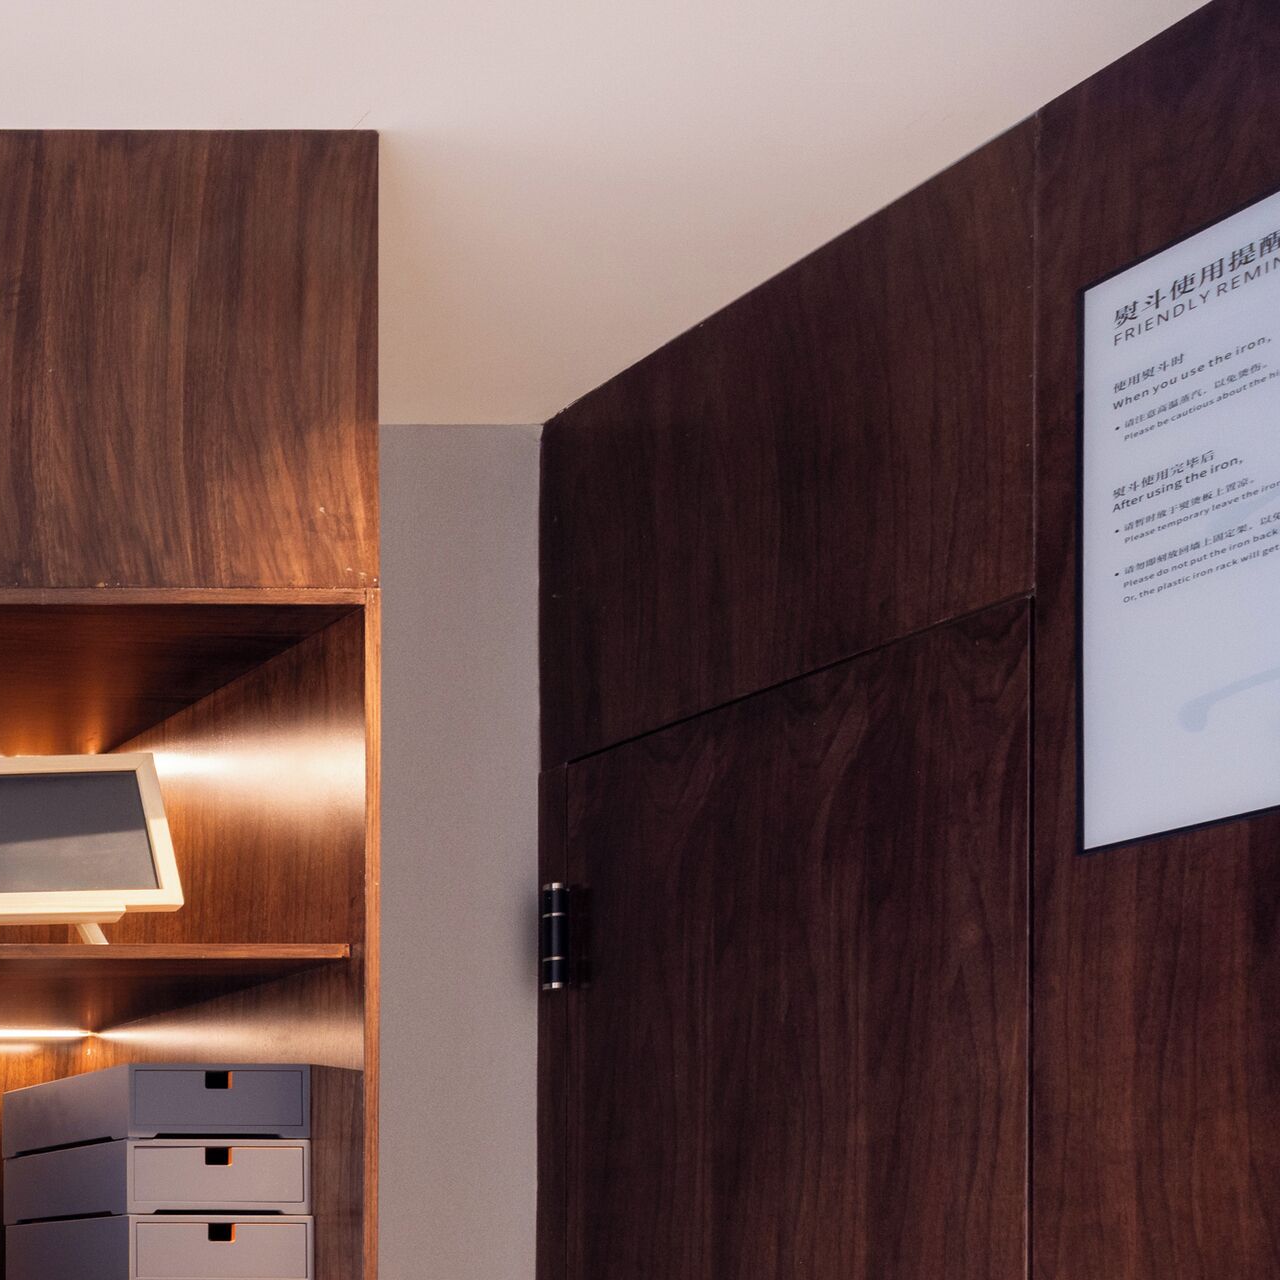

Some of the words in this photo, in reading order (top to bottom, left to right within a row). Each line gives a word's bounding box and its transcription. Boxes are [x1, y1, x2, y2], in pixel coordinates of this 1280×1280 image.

[1114, 290, 1210, 346] FRIENDLY
[1113, 353, 1184, 393] 使用熨斗时
[1113, 390, 1149, 410] When
[1153, 376, 1178, 395] you
[1181, 365, 1205, 380] use
[1208, 352, 1232, 368] the
[1236, 336, 1271, 356] iron,
[1124, 425, 1155, 440] Please
[1157, 418, 1169, 428] be
[1170, 399, 1214, 421] cautious
[1216, 384, 1247, 402] about
[1249, 376, 1266, 388] the
[1112, 494, 1144, 513] After
[1146, 480, 1182, 499] using
[1185, 470, 1207, 483] the
[1210, 456, 1243, 474] iron,
[1113, 450, 1215, 499] 熨斗使用完毕后
[1124, 528, 1155, 543] Please
[1157, 508, 1210, 531] temporary
[1212, 496, 1239, 511] leave
[1242, 489, 1259, 500] the
[1123, 573, 1155, 588] Please
[1157, 568, 1169, 577] do
[1171, 561, 1188, 572] not
[1190, 554, 1207, 566] put
[1210, 548, 1227, 558] the
[1229, 537, 1250, 551] iron
[1253, 528, 1278, 543] back
[1139, 588, 1155, 598] the
[1157, 576, 1191, 593] plastic
[1192, 566, 1214, 579] iron
[1215, 558, 1238, 571] rack
[1240, 550, 1260, 563] will
[1262, 544, 1280, 557] get
